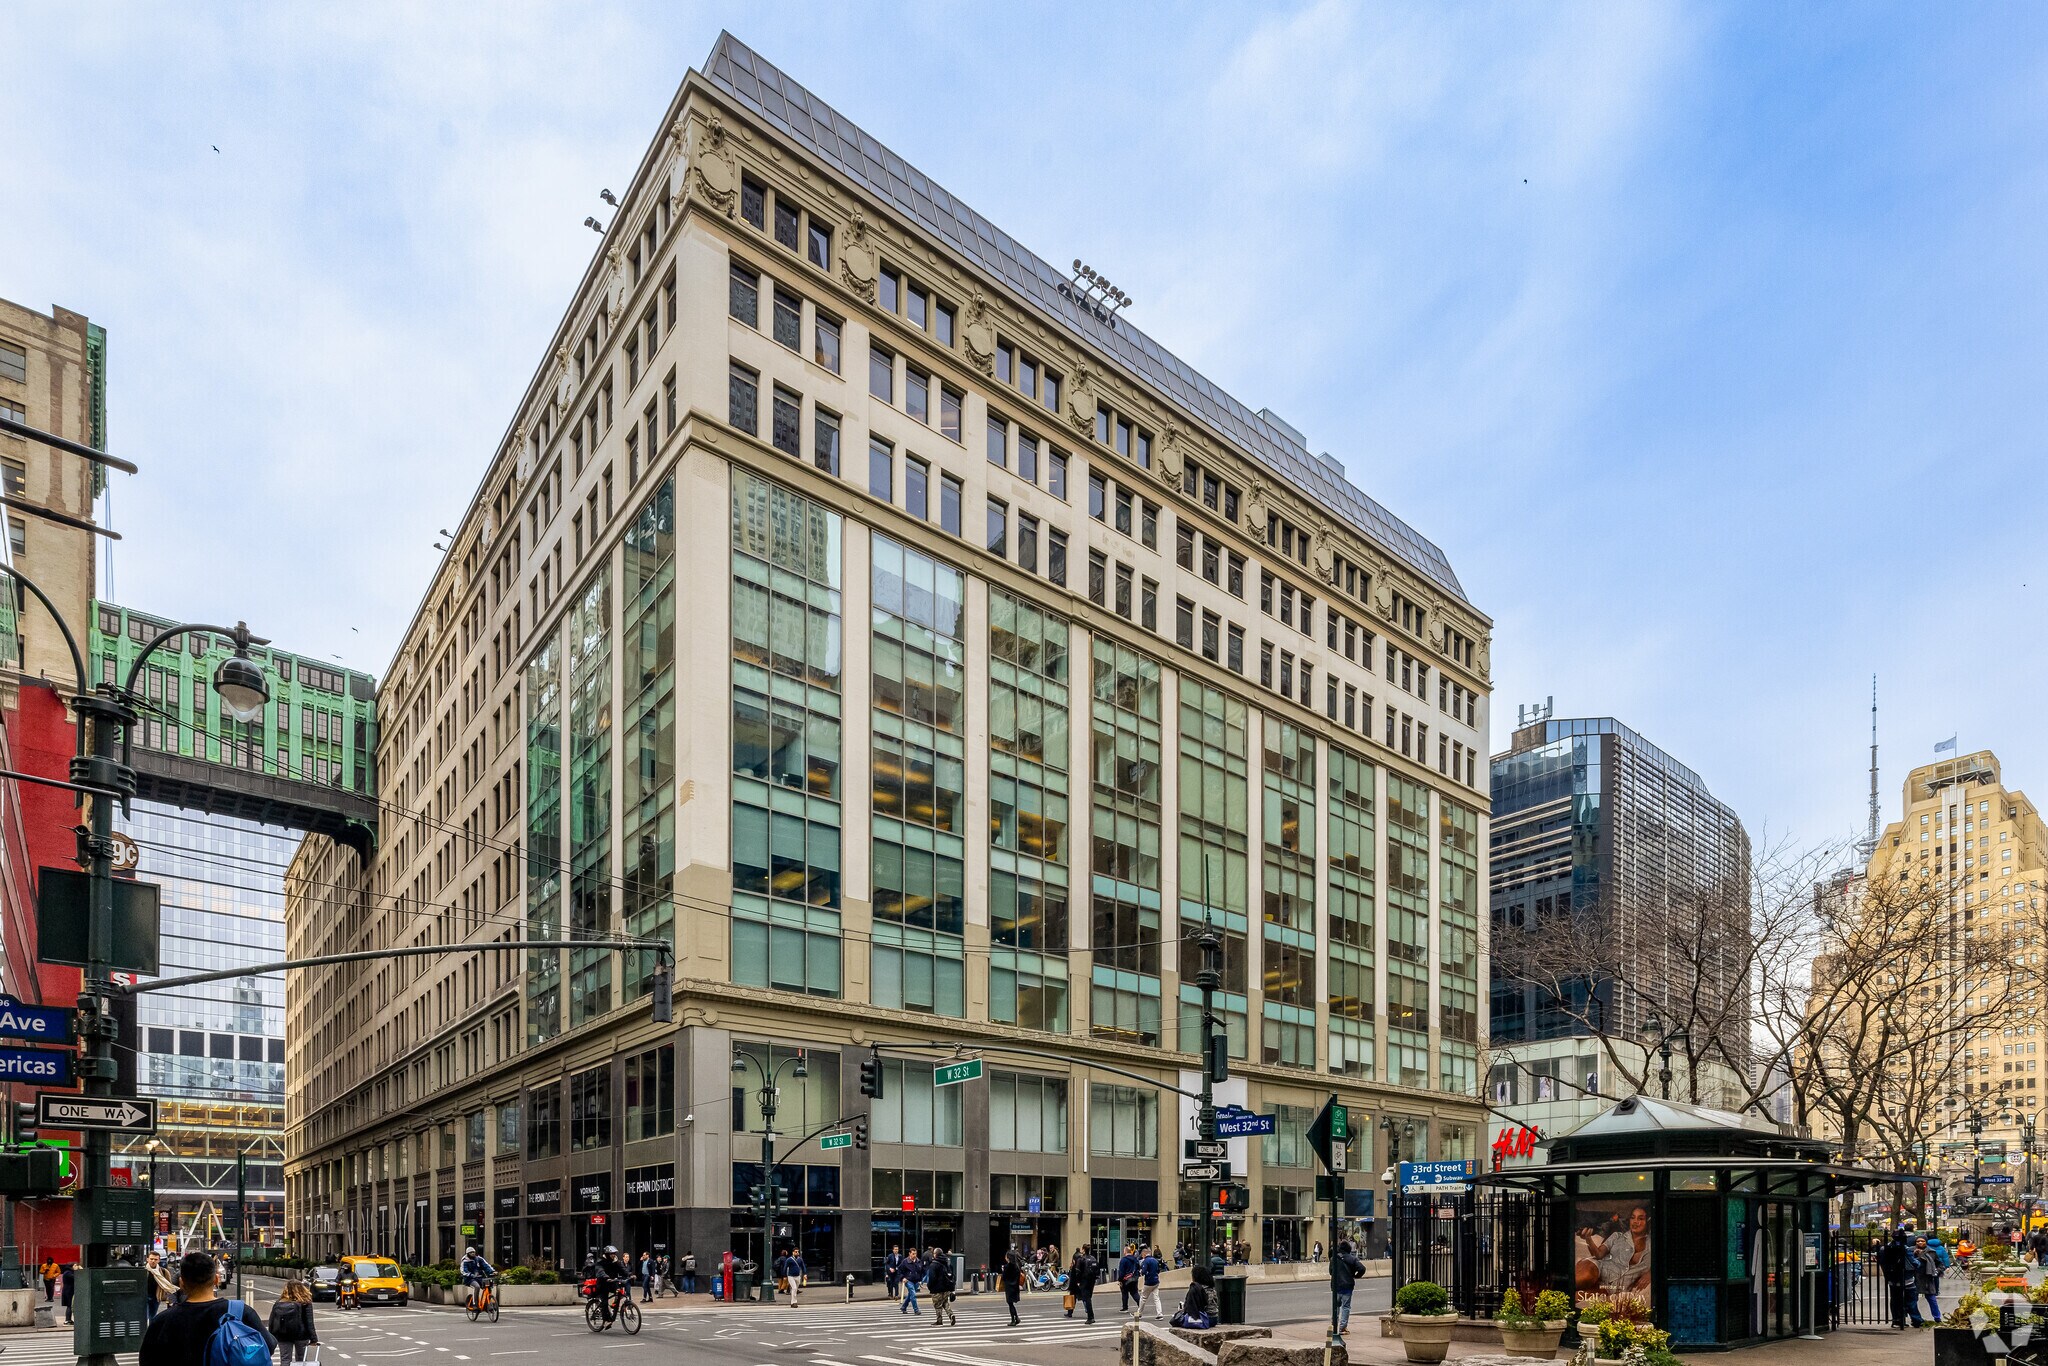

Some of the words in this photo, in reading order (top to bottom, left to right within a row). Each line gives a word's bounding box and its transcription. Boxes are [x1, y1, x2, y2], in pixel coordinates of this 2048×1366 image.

[0, 1012, 46, 1031] Ave
[0, 1055, 56, 1075] ericas
[947, 1070, 952, 1080] W
[954, 1068, 961, 1079] 32
[963, 1066, 969, 1077] St
[60, 1106, 89, 1117] ONE
[104, 1108, 136, 1120] WAY
[1220, 1123, 1240, 1133] West
[1242, 1120, 1259, 1132] 32nd
[1261, 1120, 1270, 1130] St
[1413, 1164, 1432, 1174] 33rd
[1434, 1163, 1462, 1173] Street
[626, 1182, 636, 1194] THE
[636, 1180, 651, 1193] PENN
[651, 1178, 674, 1192] DISTRICT
[1577, 1290, 1607, 1303] State
